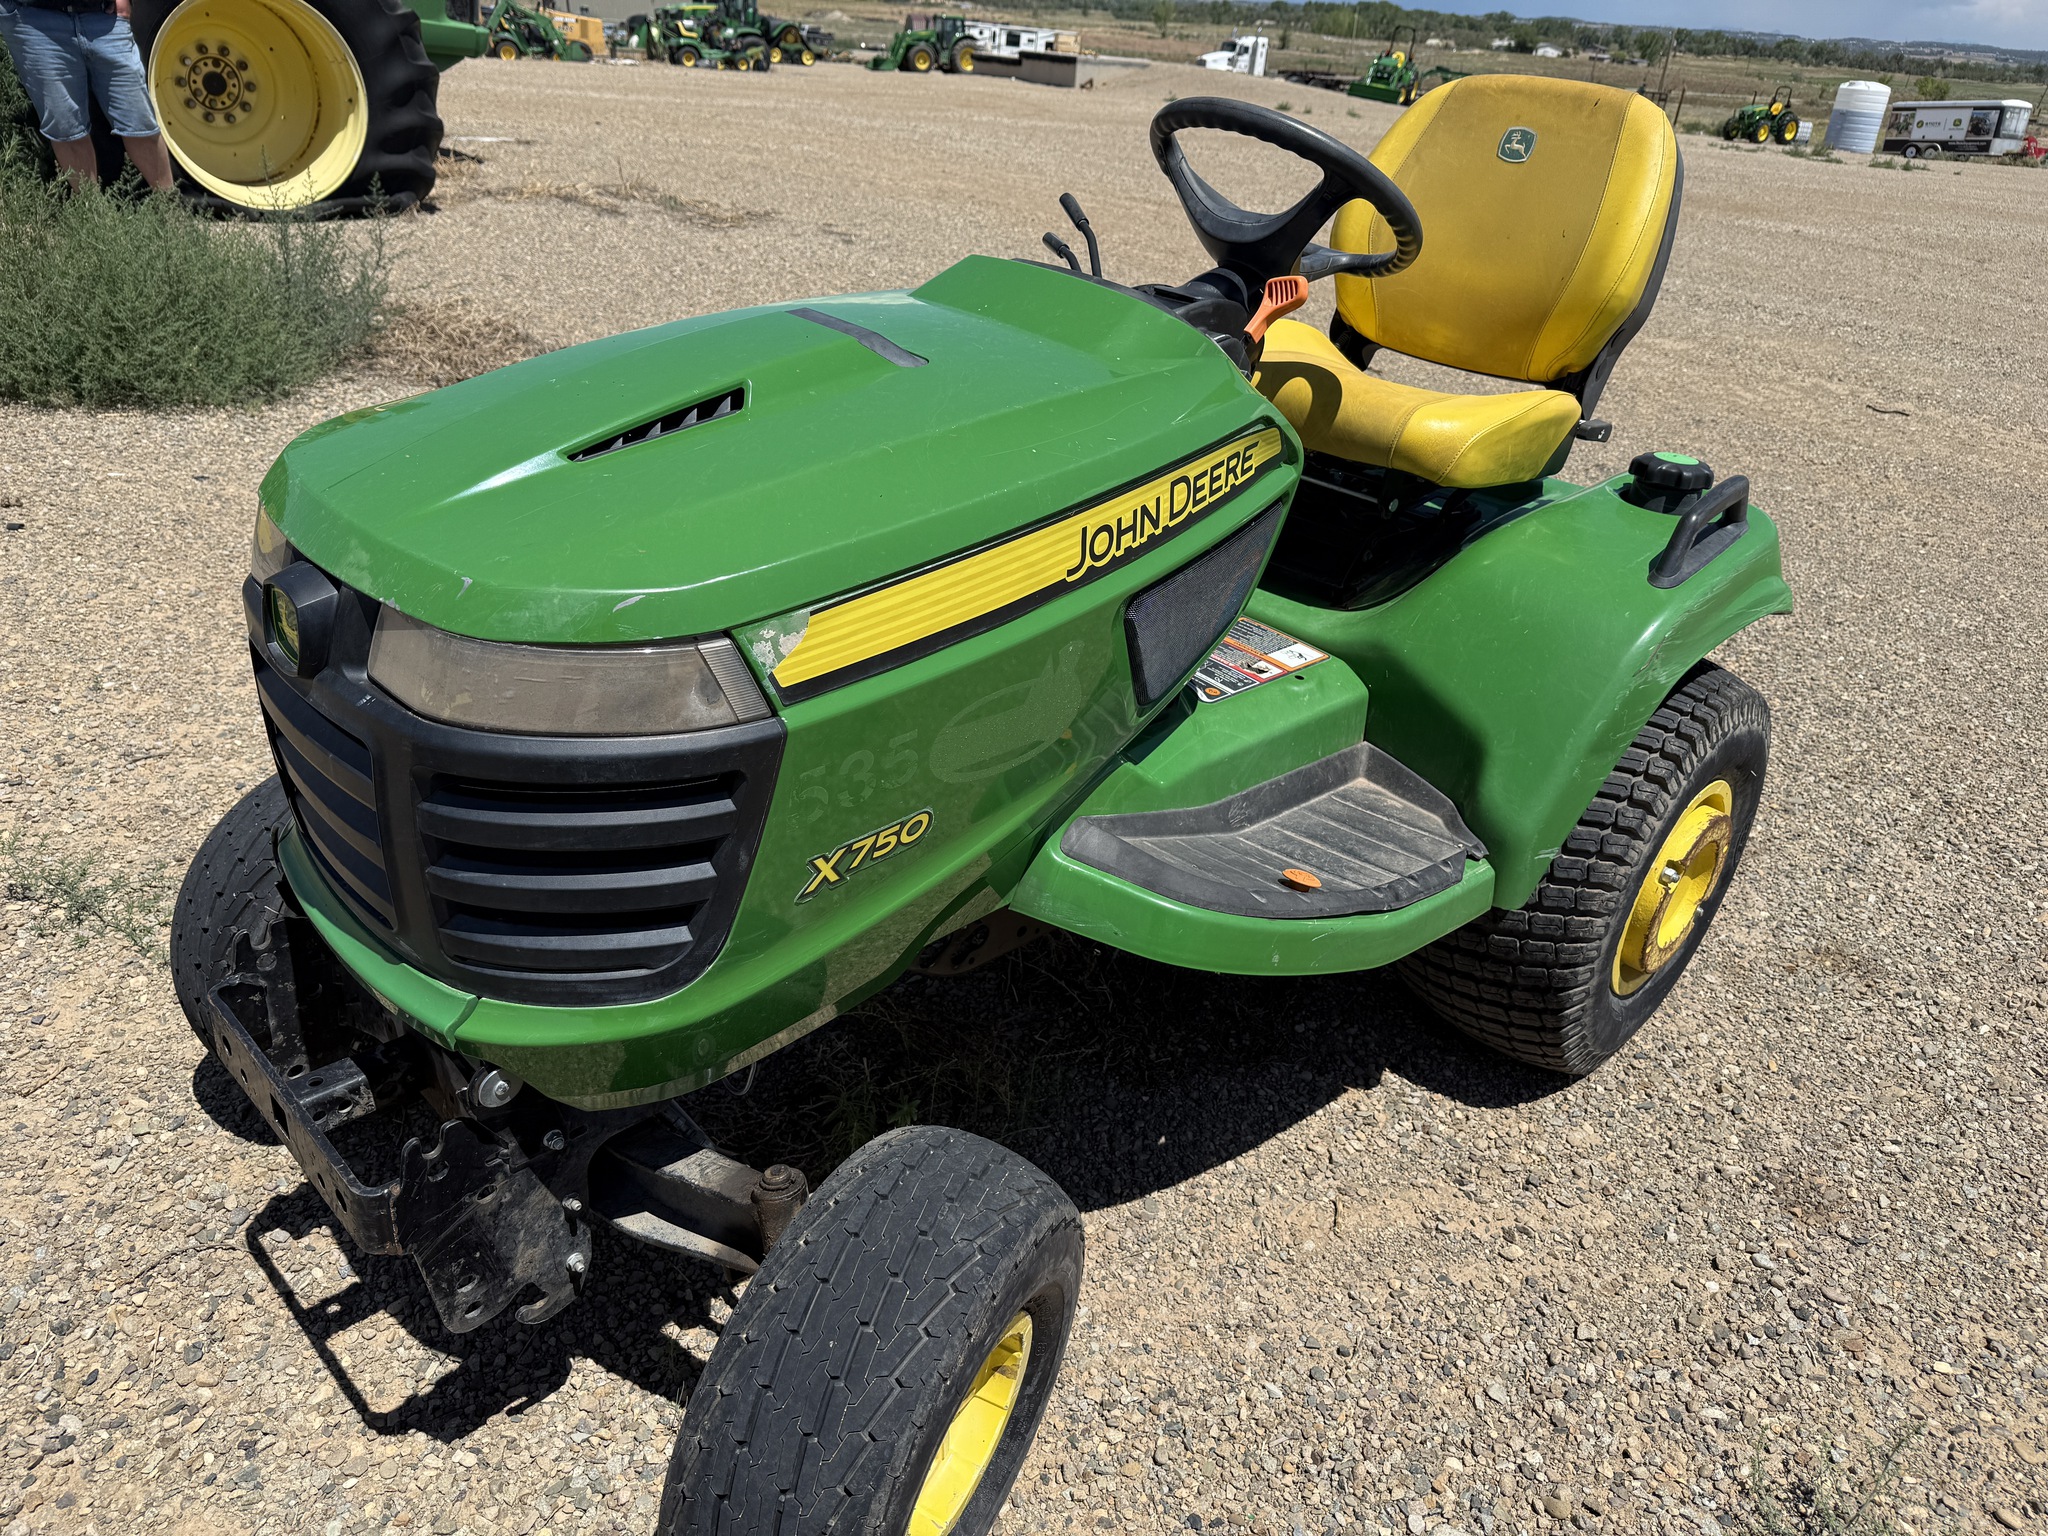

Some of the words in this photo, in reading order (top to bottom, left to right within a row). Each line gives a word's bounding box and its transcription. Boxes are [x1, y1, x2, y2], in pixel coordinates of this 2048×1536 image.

[1066, 496, 1162, 580] JOHN
[1169, 440, 1261, 525] DEERE
[801, 810, 932, 898] X750
